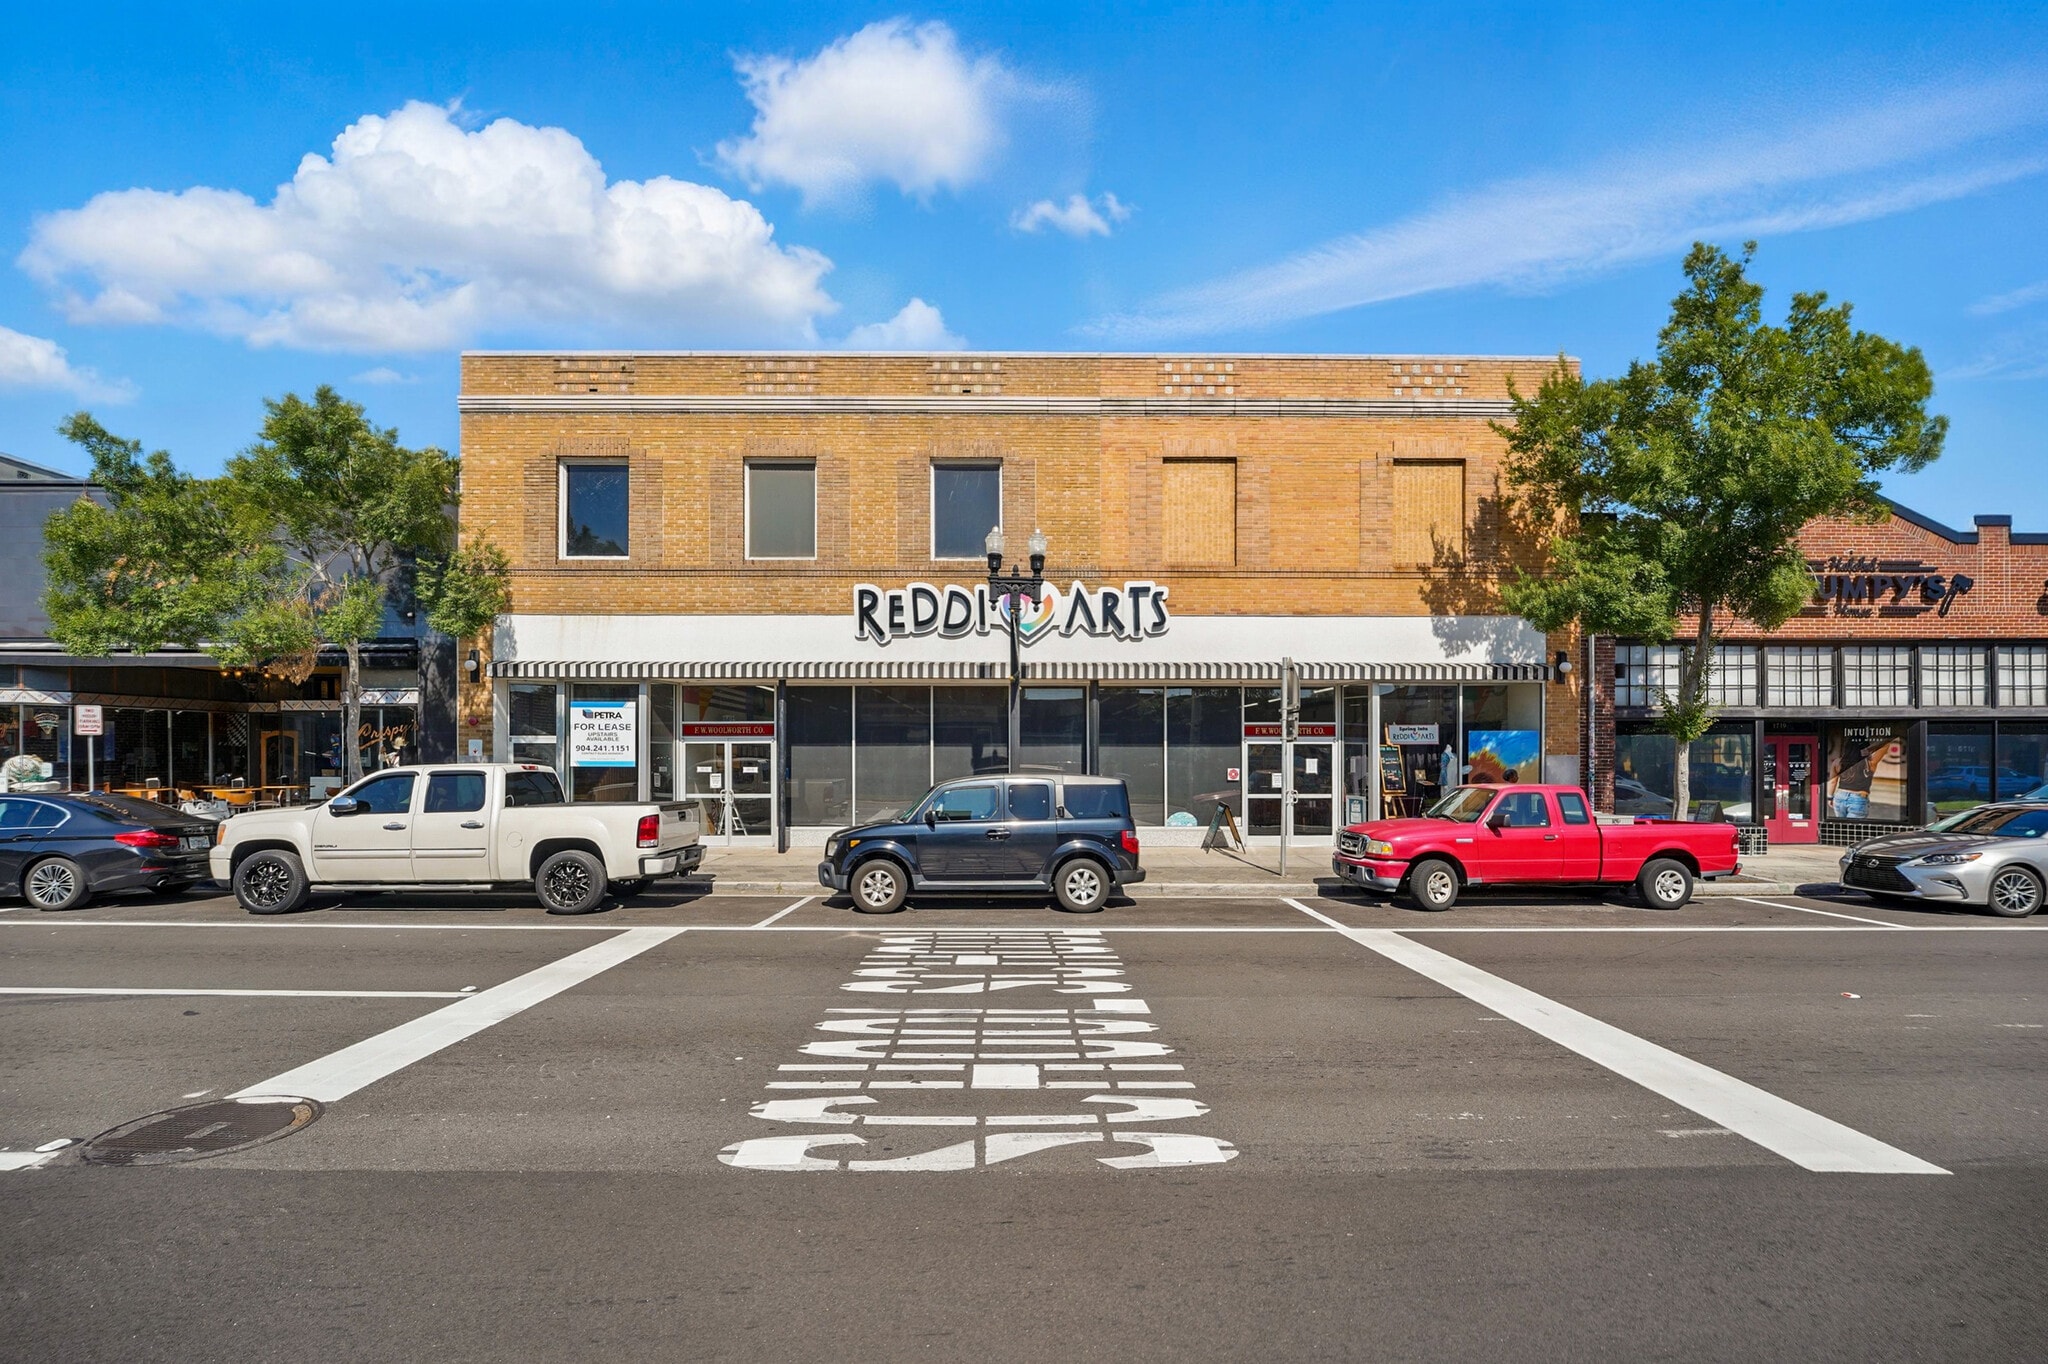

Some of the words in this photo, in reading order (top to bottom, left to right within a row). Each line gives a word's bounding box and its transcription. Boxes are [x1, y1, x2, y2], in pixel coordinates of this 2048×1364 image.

[1817, 574, 1946, 601] UMPY'S
[857, 585, 986, 638] REDDI
[1063, 585, 1168, 637] ARTS
[594, 711, 622, 719] PETRA
[574, 723, 595, 731] FOR
[598, 723, 632, 731] LEASE
[1844, 726, 1891, 738] INTUITION
[575, 744, 630, 752] 904.241.1151
